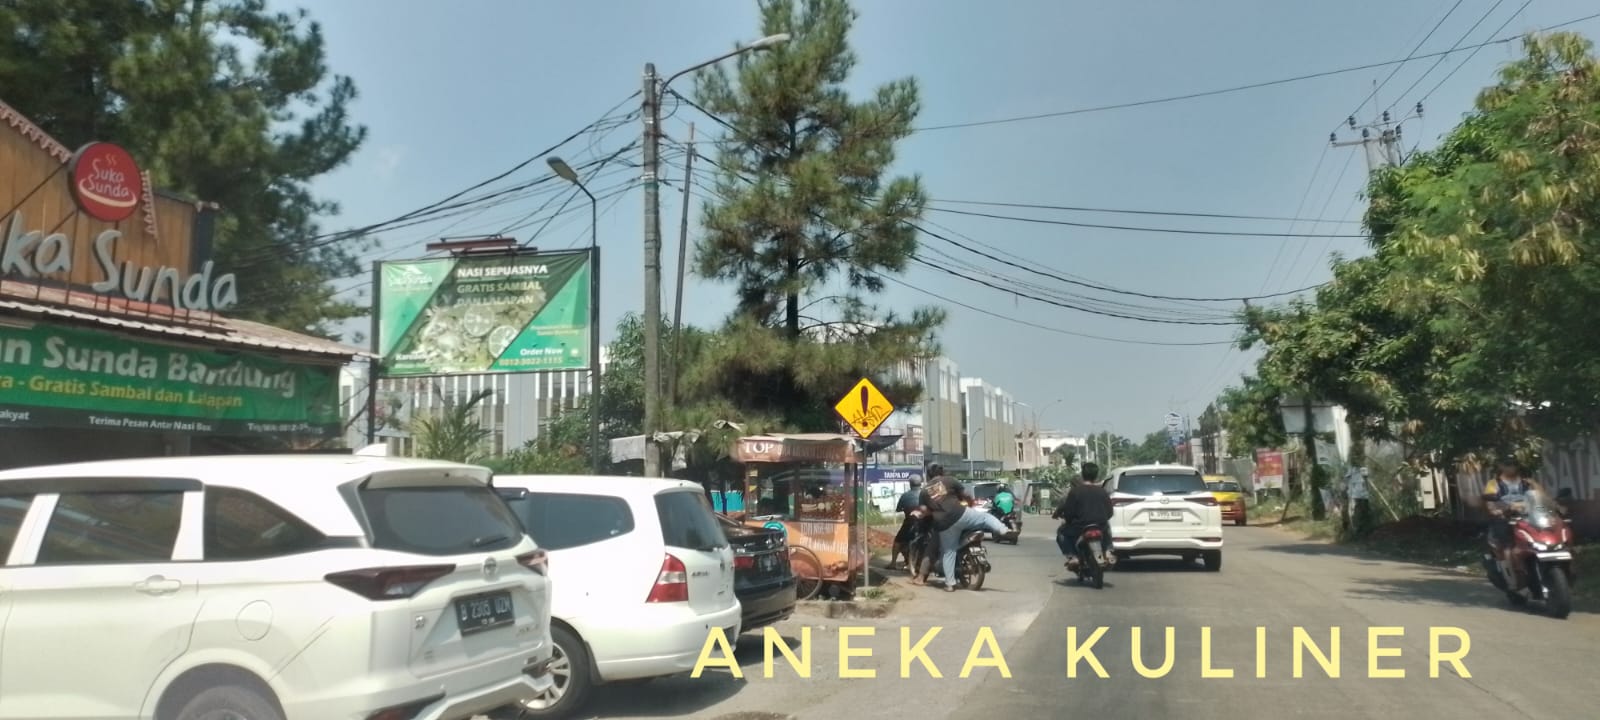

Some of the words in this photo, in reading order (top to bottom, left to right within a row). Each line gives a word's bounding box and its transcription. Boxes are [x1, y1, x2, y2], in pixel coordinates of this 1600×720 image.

[92, 157, 125, 182] Suka
[87, 174, 130, 198] Sunda
[92, 229, 238, 310] Sunda
[456, 268, 484, 278] NASI
[484, 264, 549, 277] SEPUASNYA
[456, 283, 496, 294] GRATIS
[497, 280, 542, 292] SAMBAL
[455, 297, 476, 307] DAN
[477, 295, 534, 305] LALAPAN
[519, 348, 544, 357] Order
[545, 347, 564, 355] Now
[43, 335, 158, 379] Sunda
[167, 352, 297, 399] Bandung
[29, 375, 86, 396] Gratis
[89, 380, 152, 401] Sambal
[154, 388, 183, 404] dan
[188, 389, 242, 411] Lalapan
[88, 415, 121, 427] Terima
[122, 417, 149, 429] Pesan
[173, 421, 195, 431] Nasi
[460, 603, 469, 622] B
